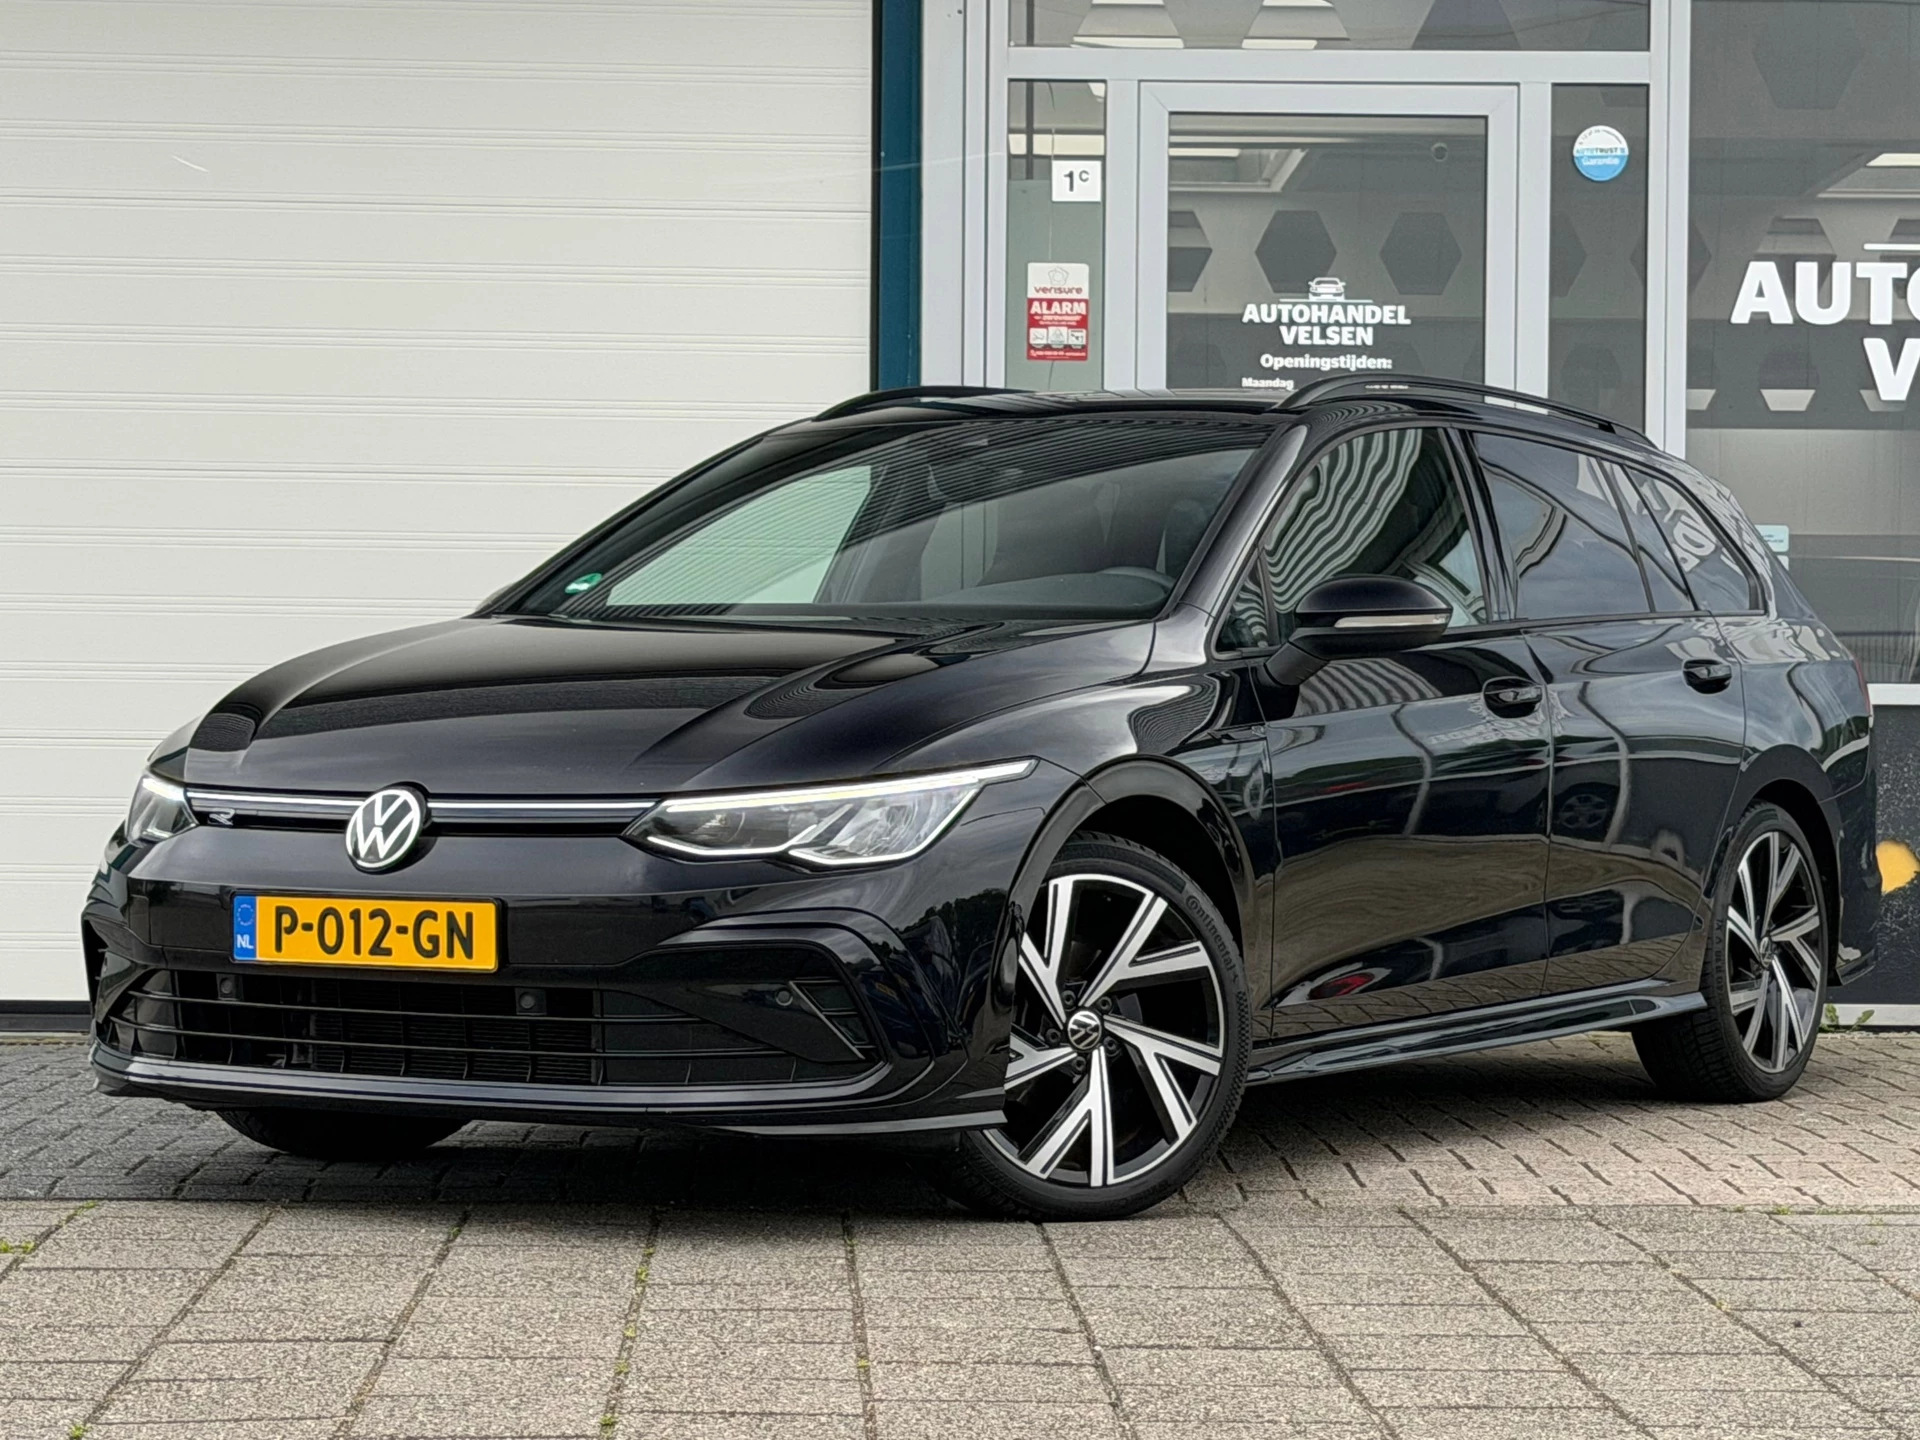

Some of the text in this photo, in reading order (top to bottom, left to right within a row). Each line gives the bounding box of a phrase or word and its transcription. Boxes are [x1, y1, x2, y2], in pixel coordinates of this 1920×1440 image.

[1033, 286, 1083, 294] verisure
[1730, 261, 1920, 325] AUT
[1030, 301, 1087, 315] ALARM
[1242, 304, 1411, 325] AUTOHANDEL
[1279, 326, 1374, 346] VELSEN
[1260, 354, 1393, 371] Openingstijden:
[1242, 377, 1294, 390] Maandag
[274, 905, 474, 960] P-012-GN
[1185, 894, 1237, 973] Continental
[236, 935, 254, 949] NL
